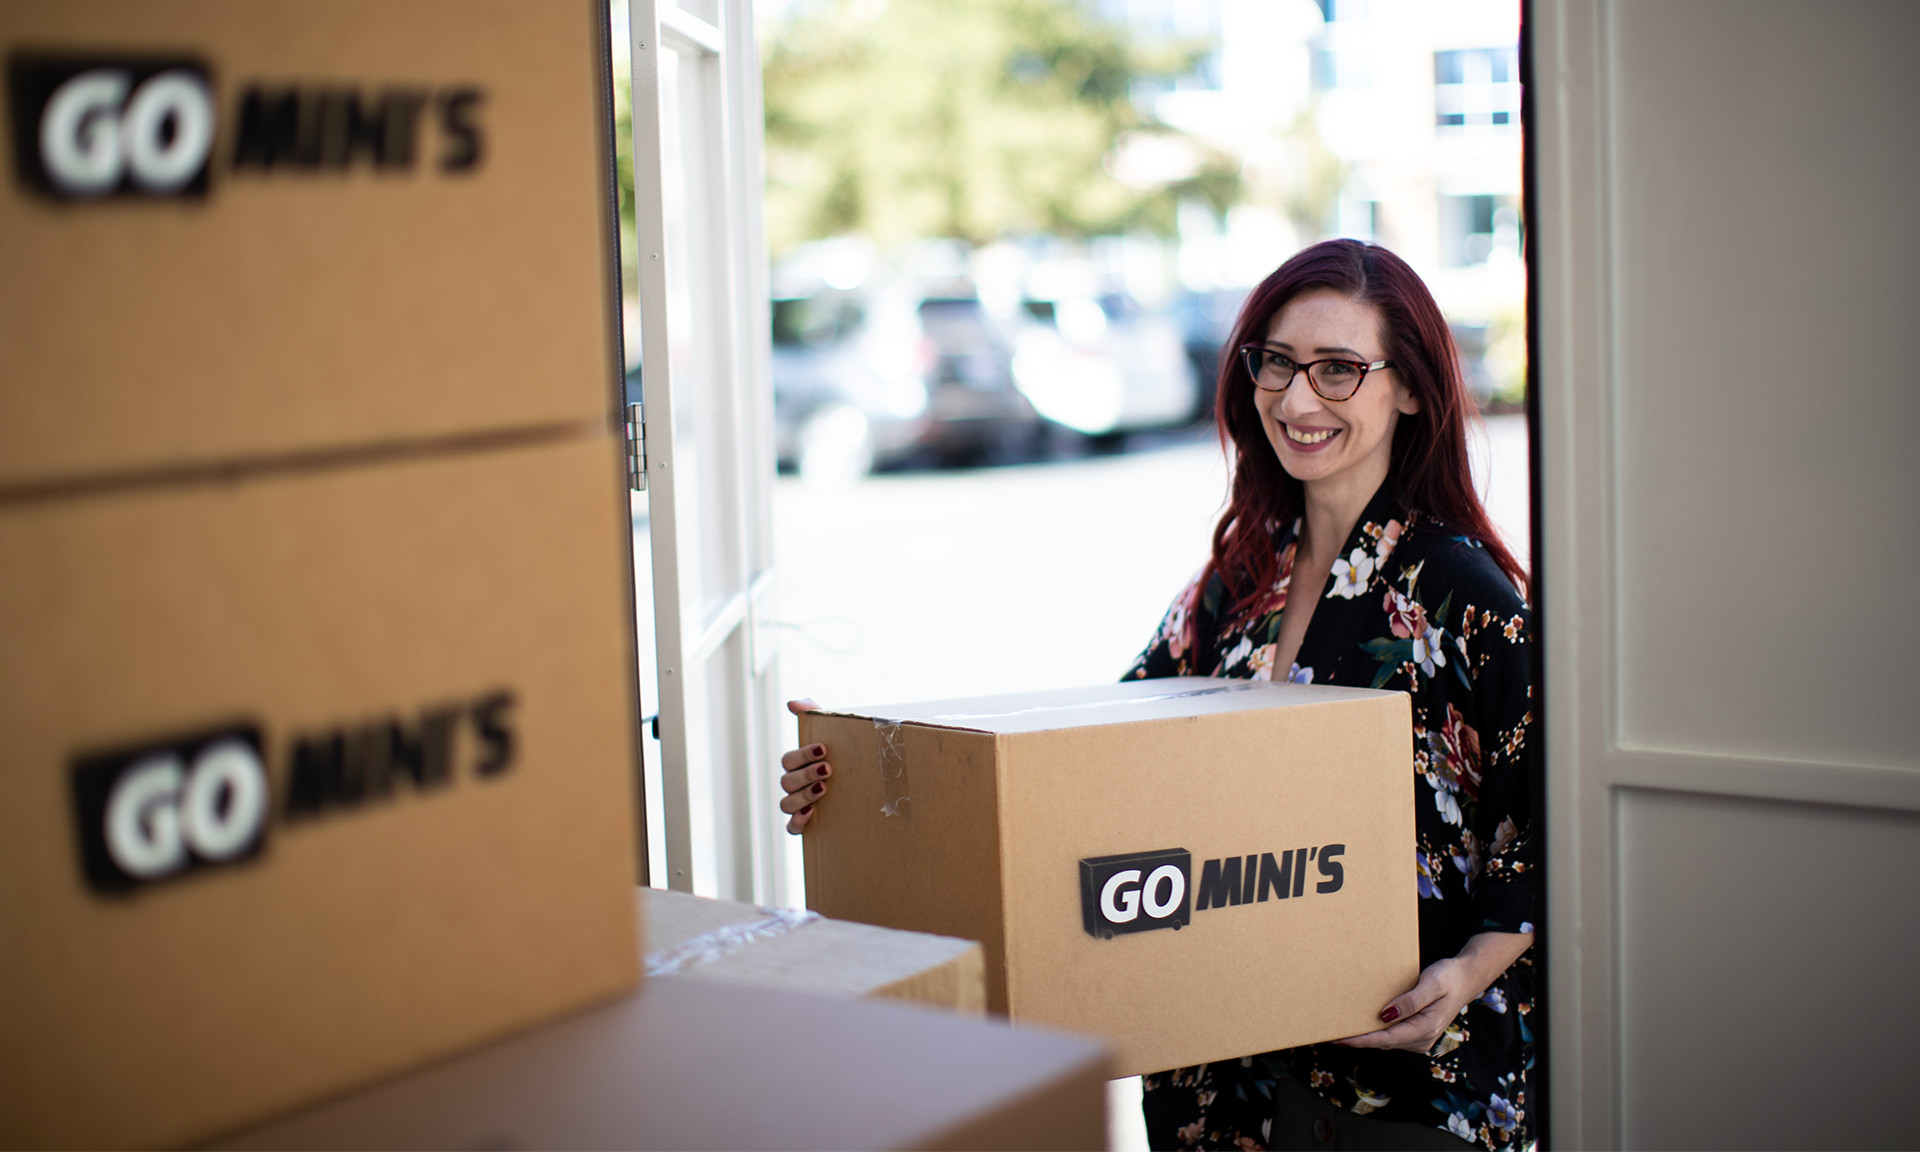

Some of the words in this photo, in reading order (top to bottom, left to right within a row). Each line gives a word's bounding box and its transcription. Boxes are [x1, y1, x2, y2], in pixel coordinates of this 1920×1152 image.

[40, 70, 216, 195] GO
[105, 737, 268, 879] GO
[1100, 864, 1186, 924] GO
[1195, 843, 1346, 912] MINI'S
